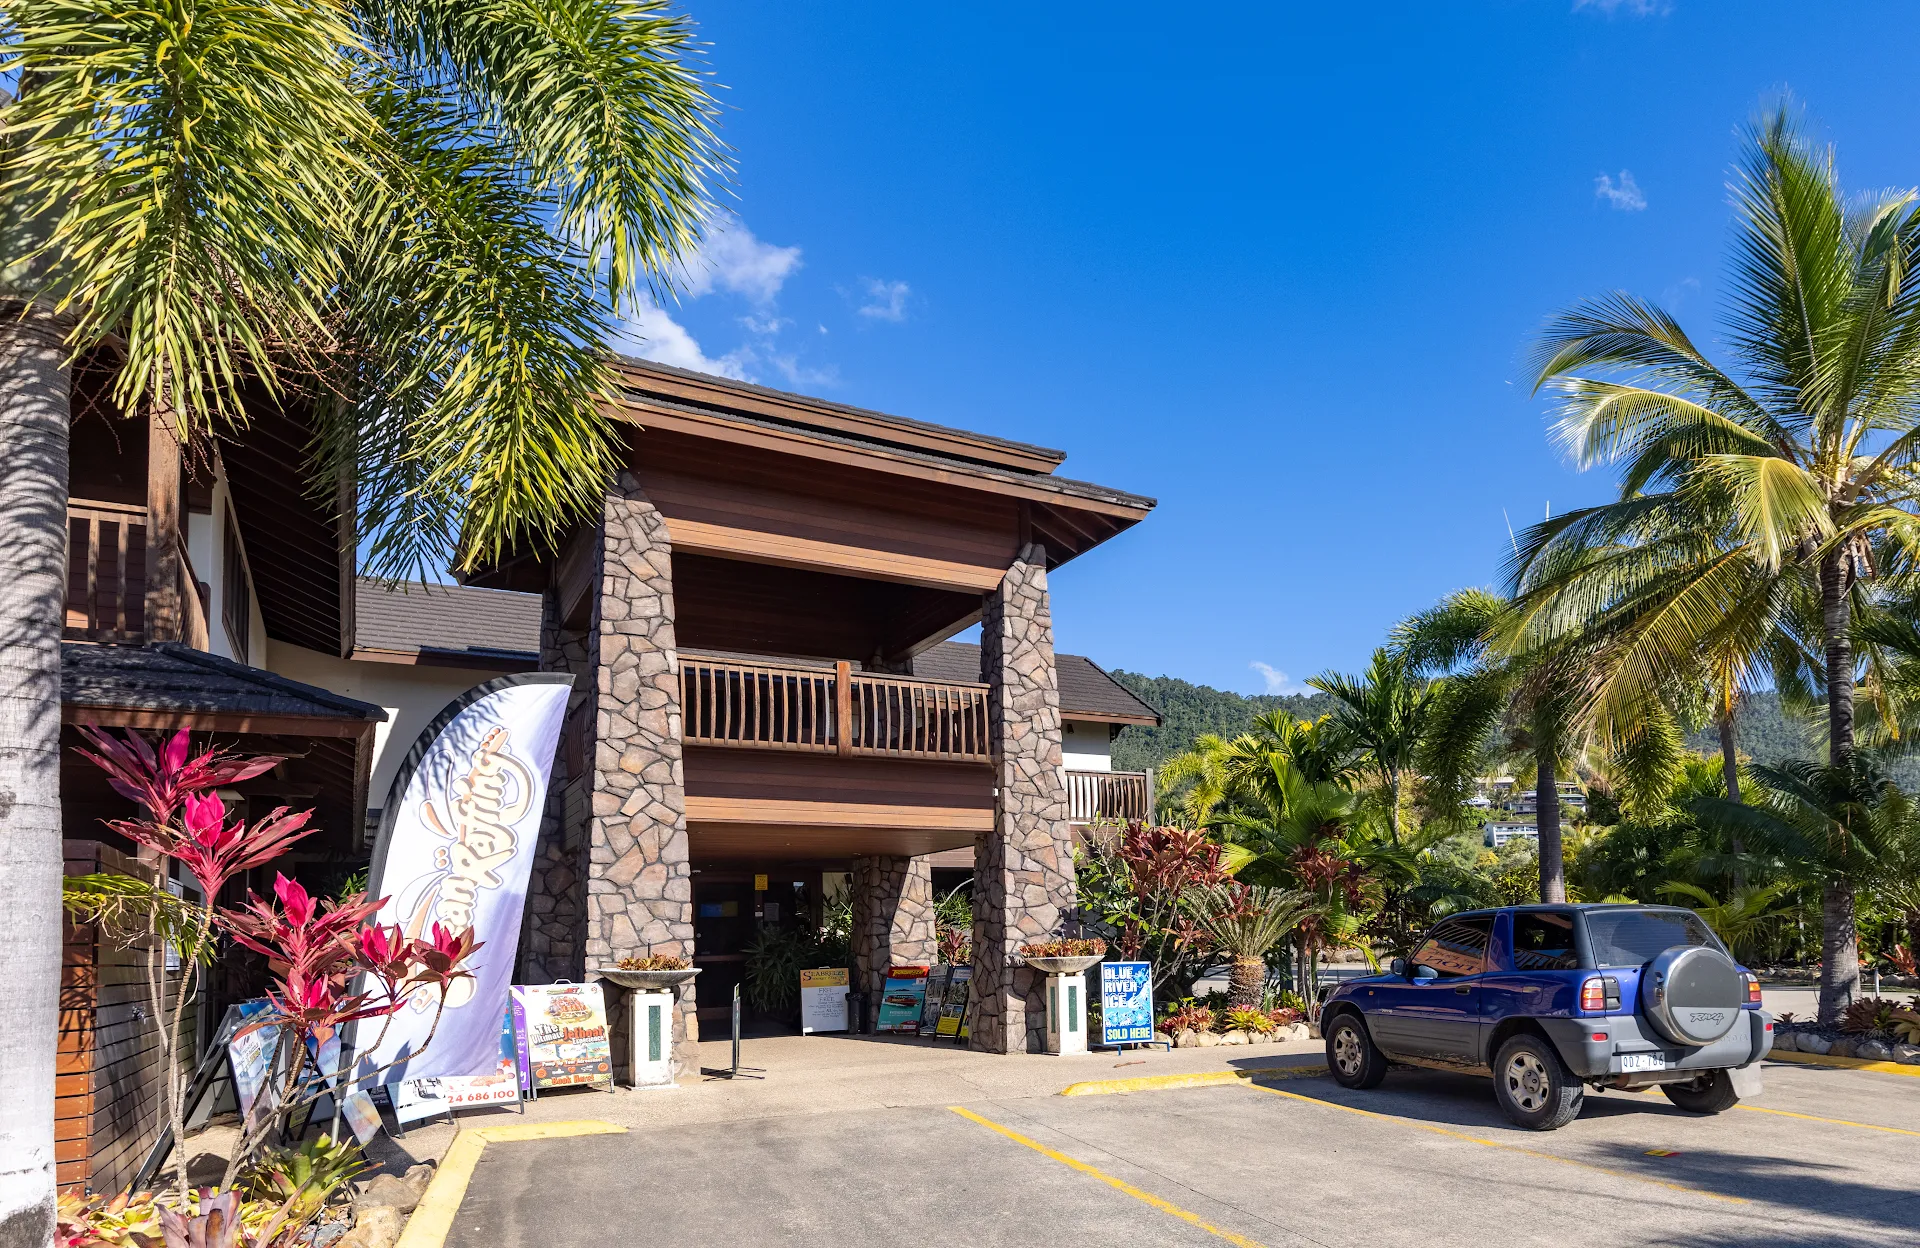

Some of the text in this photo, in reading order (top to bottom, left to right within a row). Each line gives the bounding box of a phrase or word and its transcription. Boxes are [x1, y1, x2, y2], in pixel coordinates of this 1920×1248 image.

[1104, 966, 1133, 979] BLUE
[1104, 980, 1137, 992] RIVER
[1105, 993, 1127, 1008] ICE
[1689, 1012, 1725, 1026] RAV4
[535, 1024, 559, 1035] The
[1107, 1027, 1150, 1040] SOLD HERE
[551, 1075, 572, 1086] Book
[467, 1091, 489, 1101] 686
[493, 1089, 515, 1099] 100
